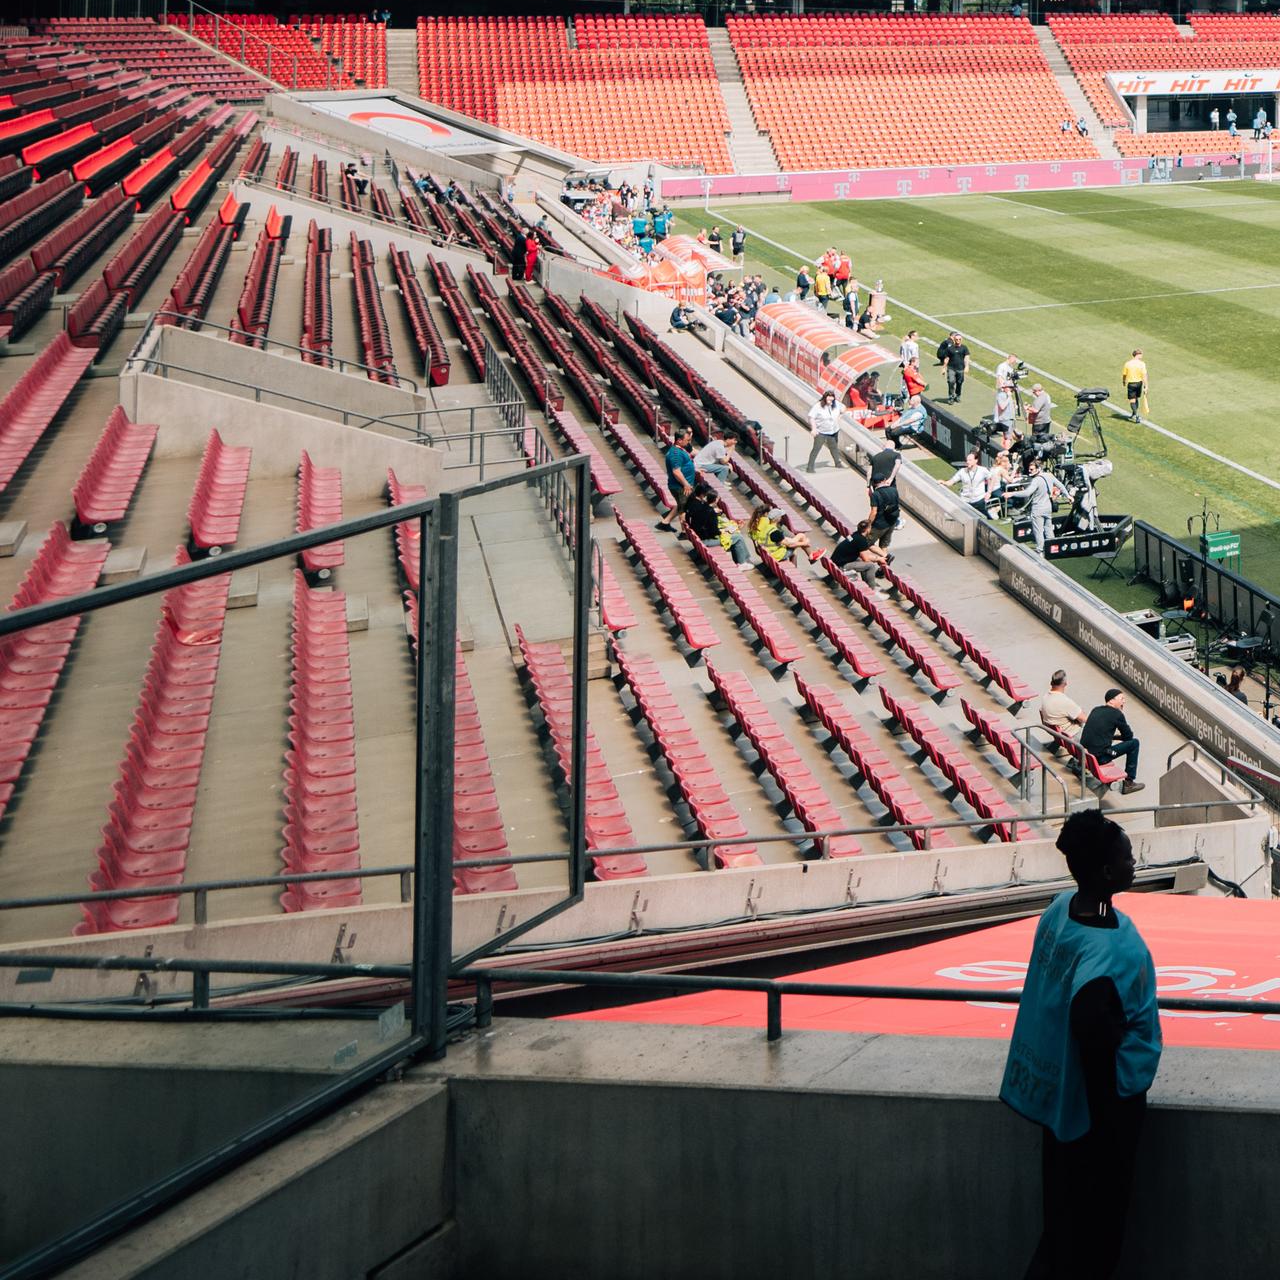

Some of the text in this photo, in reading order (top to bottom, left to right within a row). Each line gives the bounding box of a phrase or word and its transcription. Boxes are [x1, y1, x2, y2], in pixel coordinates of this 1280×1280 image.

[1117, 80, 1156, 93] HIT
[1170, 79, 1210, 92] HIT
[1224, 78, 1263, 91] HIT
[898, 179, 912, 195] T
[957, 177, 972, 193] T
[1015, 175, 1029, 190] T
[1072, 172, 1086, 187] T
[834, 183, 850, 200] T
[1011, 572, 1053, 616] Kaffee Partner
[1078, 621, 1119, 670] Hochwertige
[1119, 655, 1213, 743] Kaffee-Komplettlösungen
[1214, 730, 1228, 749] für
